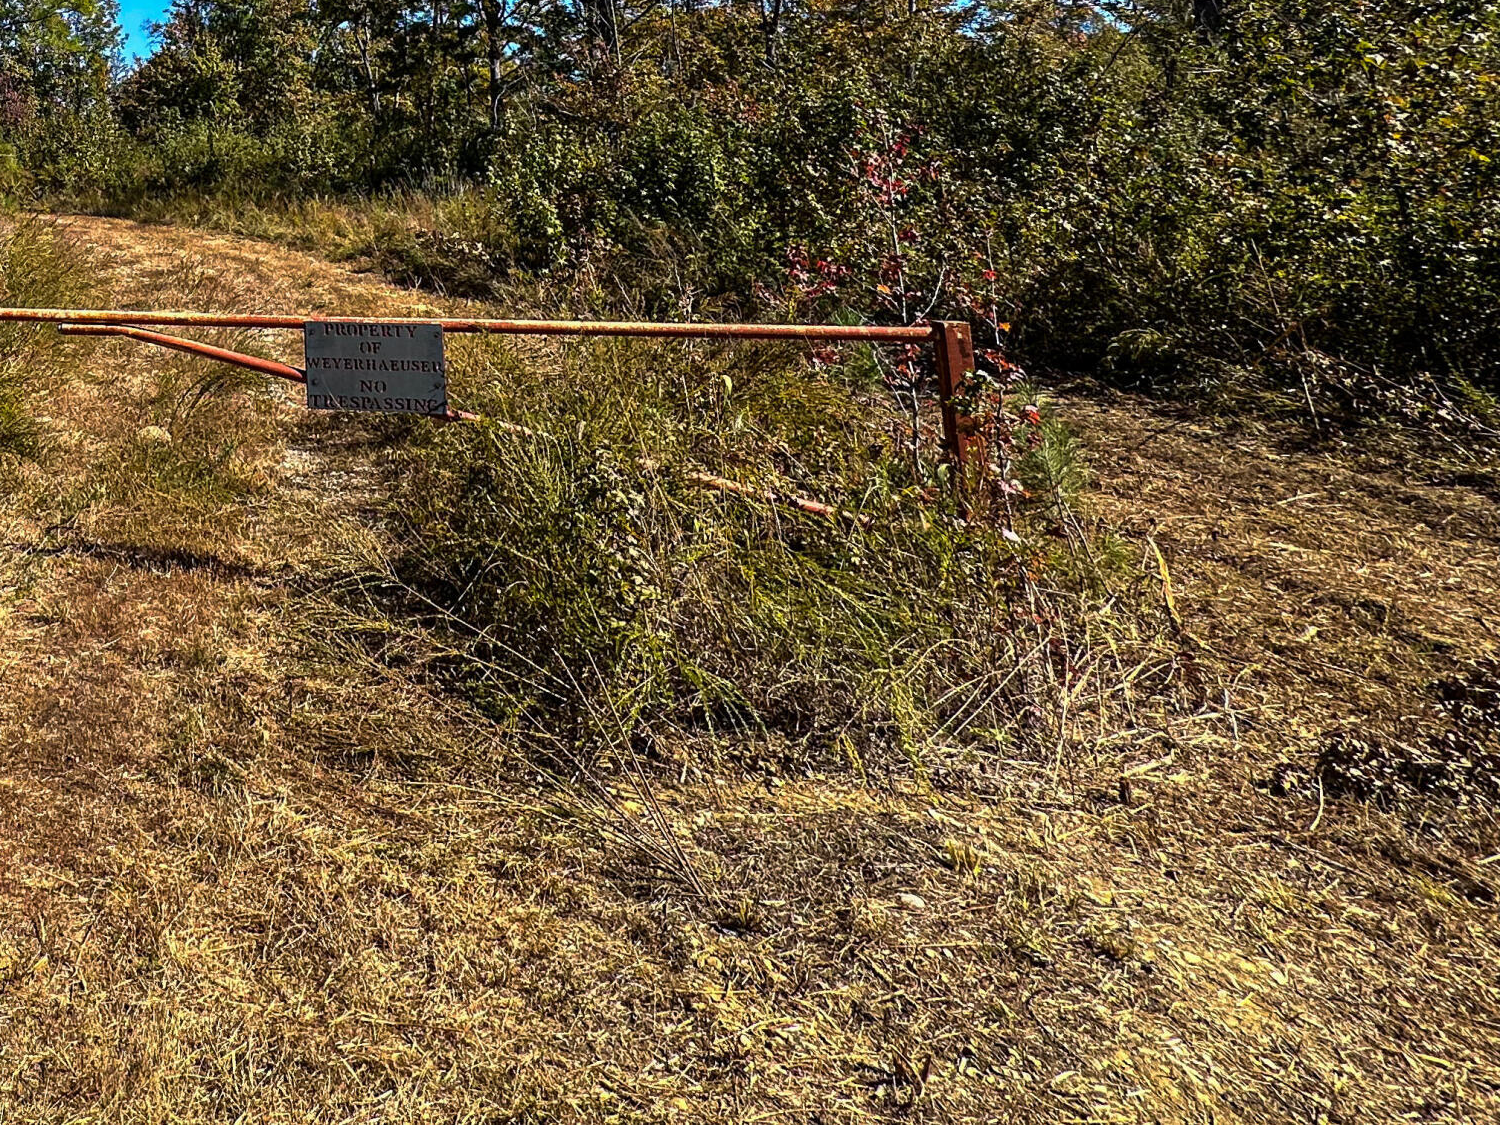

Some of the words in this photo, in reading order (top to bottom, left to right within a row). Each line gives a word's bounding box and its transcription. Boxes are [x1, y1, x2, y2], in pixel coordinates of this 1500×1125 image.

[323, 323, 418, 338] PROPERTY
[359, 341, 382, 354] OF
[306, 357, 444, 374] WEYERHAEUSER
[360, 380, 387, 393] NO
[310, 395, 438, 412] TRESPASSING
